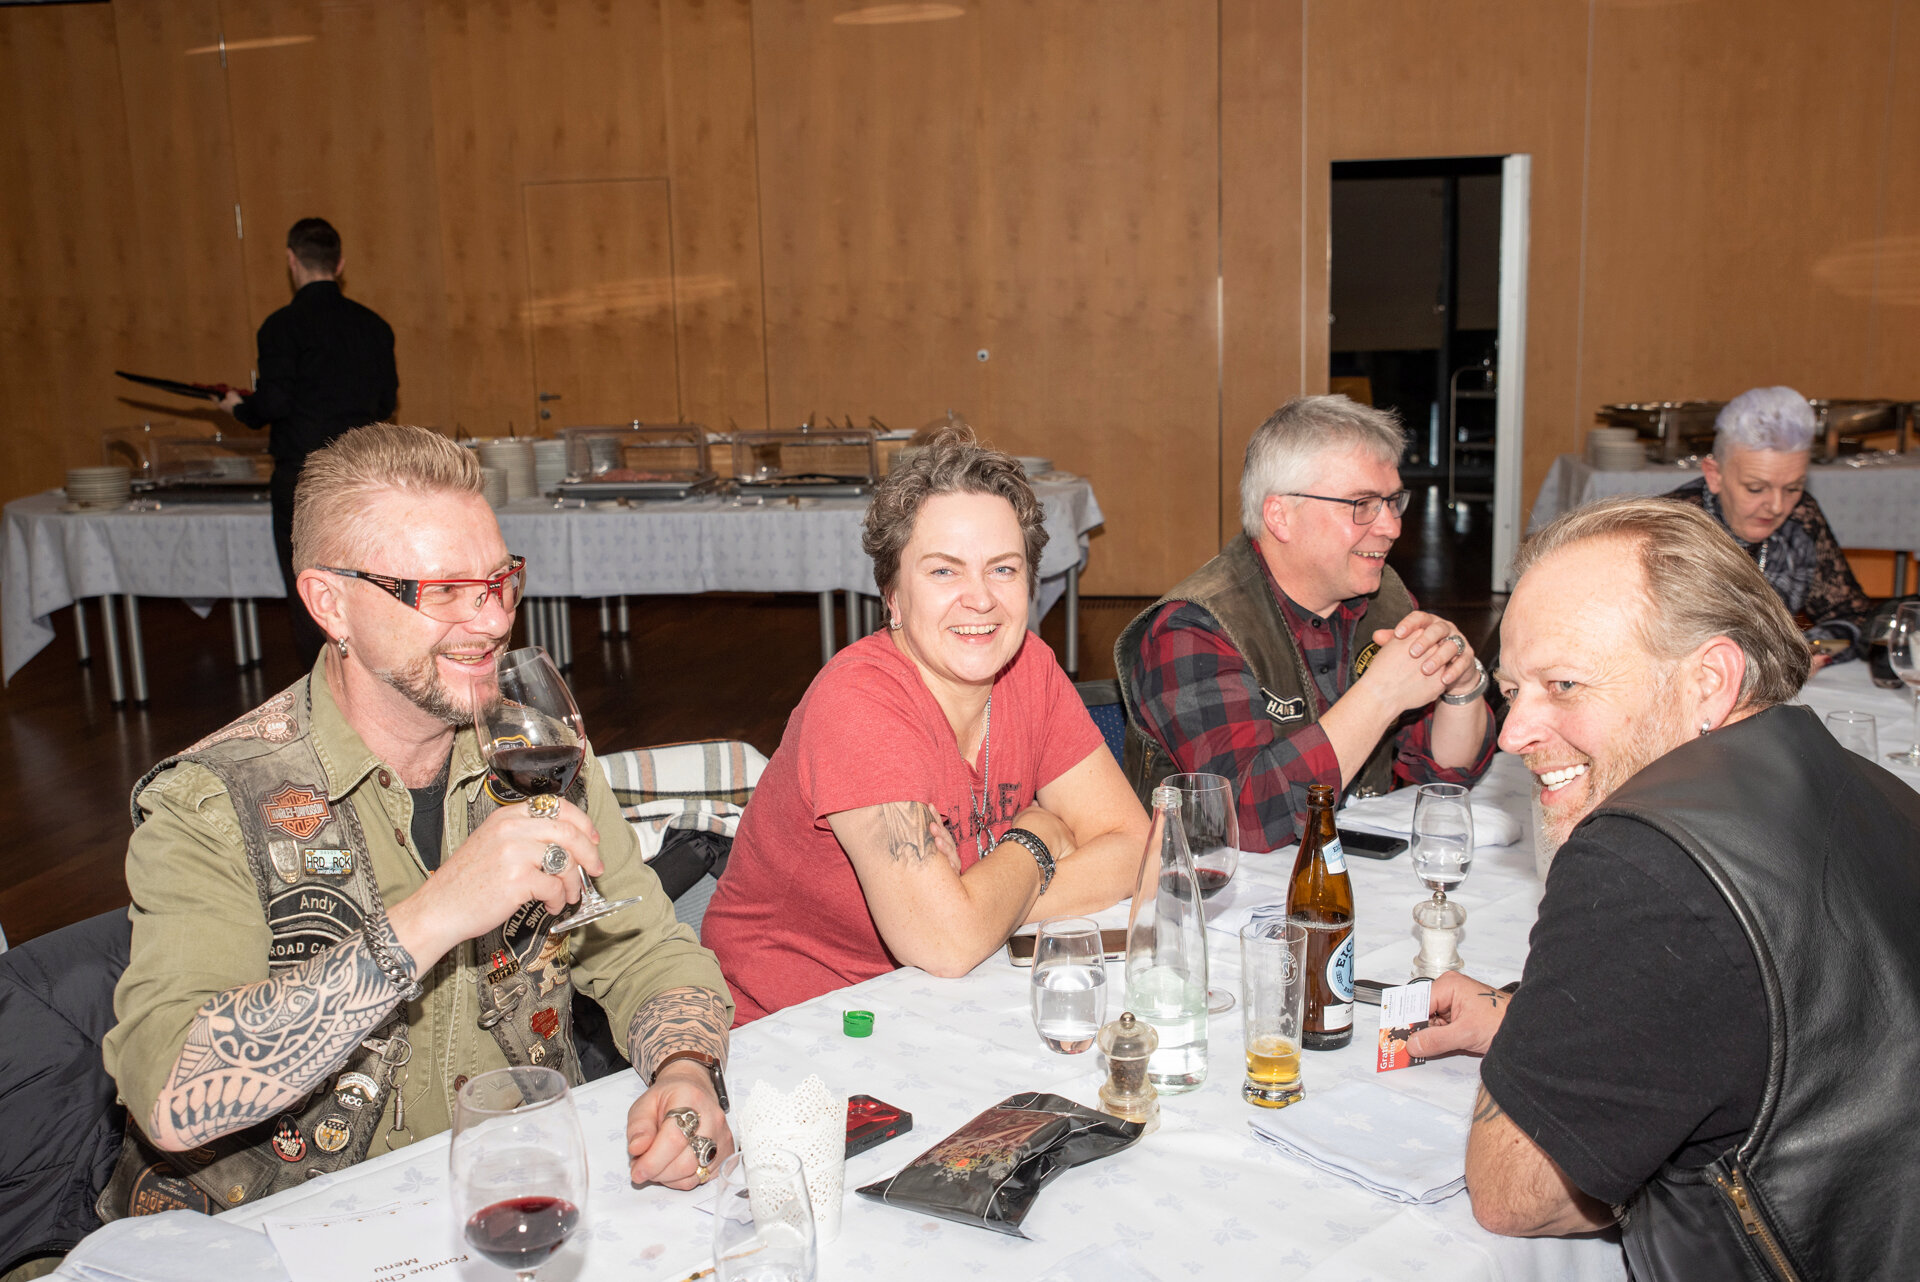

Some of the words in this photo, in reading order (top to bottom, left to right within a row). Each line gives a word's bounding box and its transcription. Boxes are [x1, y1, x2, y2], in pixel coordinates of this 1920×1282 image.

[1267, 700, 1296, 715] HANS
[306, 856, 325, 868] HRD
[333, 856, 351, 868] RCK
[300, 894, 338, 914] Andy
[270, 942, 305, 957] ROAD
[374, 1257, 419, 1273] Menu
[410, 1254, 470, 1273] Fondue
